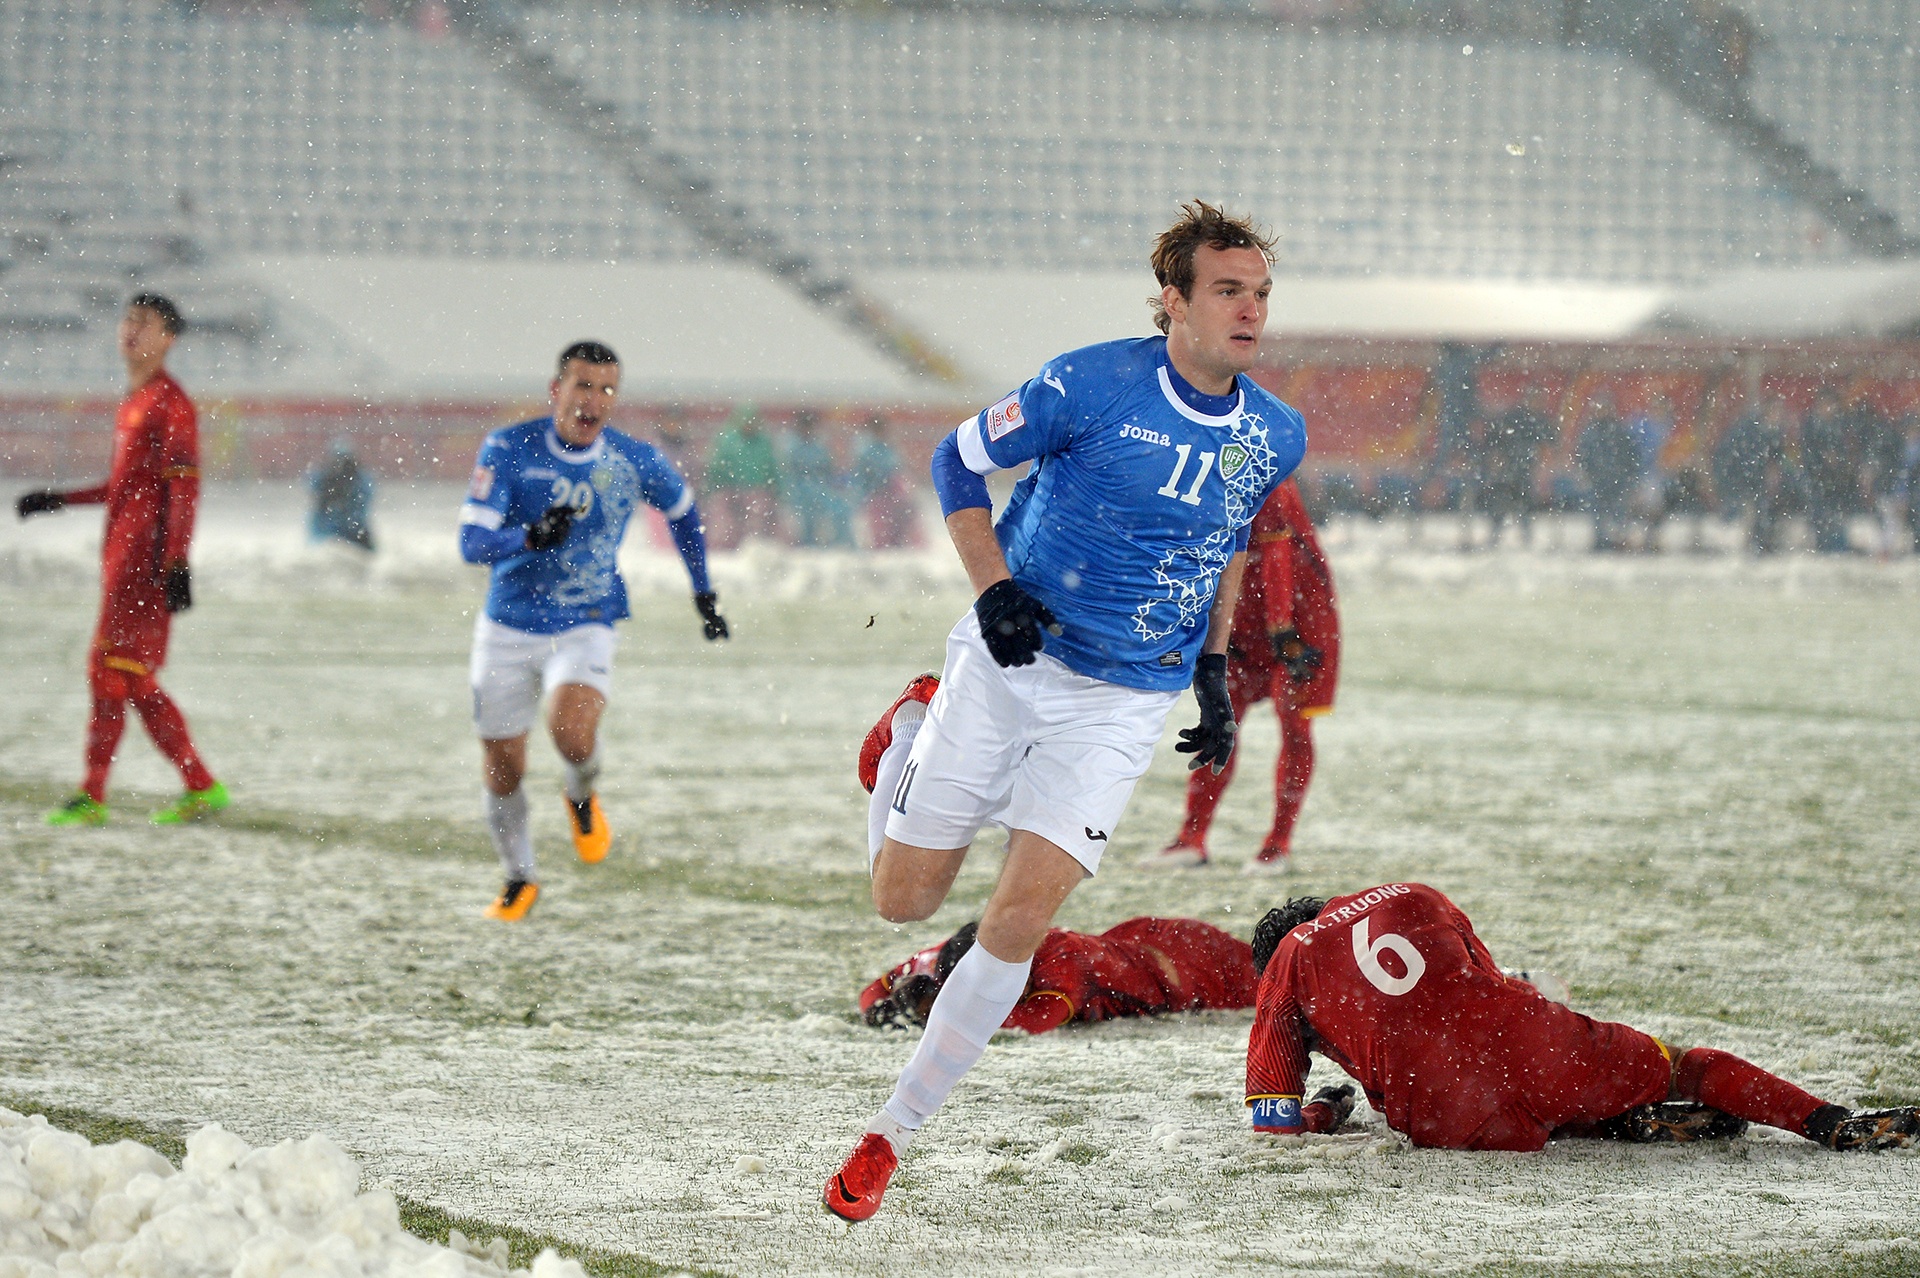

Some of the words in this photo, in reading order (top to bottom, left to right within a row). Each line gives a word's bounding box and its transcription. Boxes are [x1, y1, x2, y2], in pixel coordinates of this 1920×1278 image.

[1157, 444, 1216, 506] 11
[1224, 449, 1244, 465] UFF
[892, 759, 919, 815] 11
[1292, 883, 1411, 942] L.X.TRUONG
[1352, 916, 1426, 996] 6
